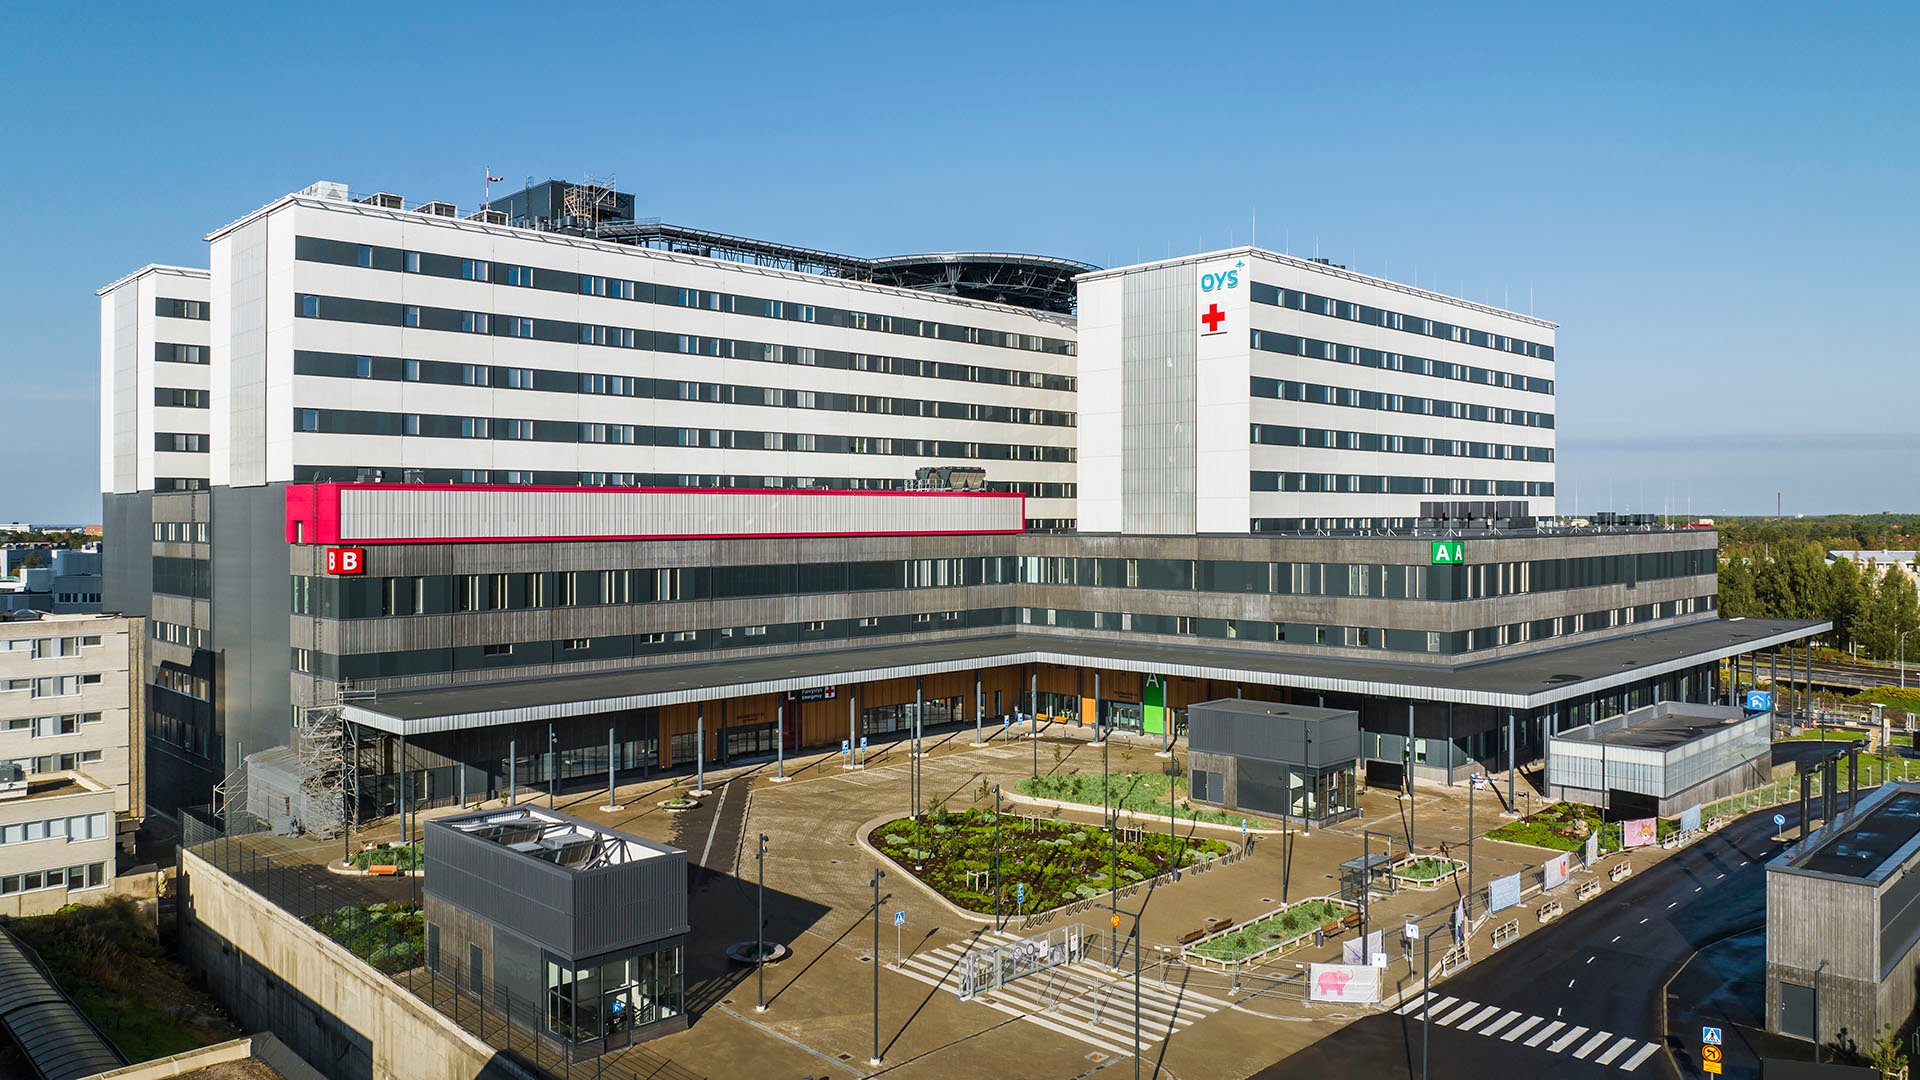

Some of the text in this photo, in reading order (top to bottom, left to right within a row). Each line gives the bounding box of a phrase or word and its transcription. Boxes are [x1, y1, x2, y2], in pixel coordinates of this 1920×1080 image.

[328, 551, 336, 571] B
[342, 551, 358, 571] B
[1435, 544, 1451, 561] A
[1454, 544, 1463, 561] A
[1145, 673, 1160, 688] A
